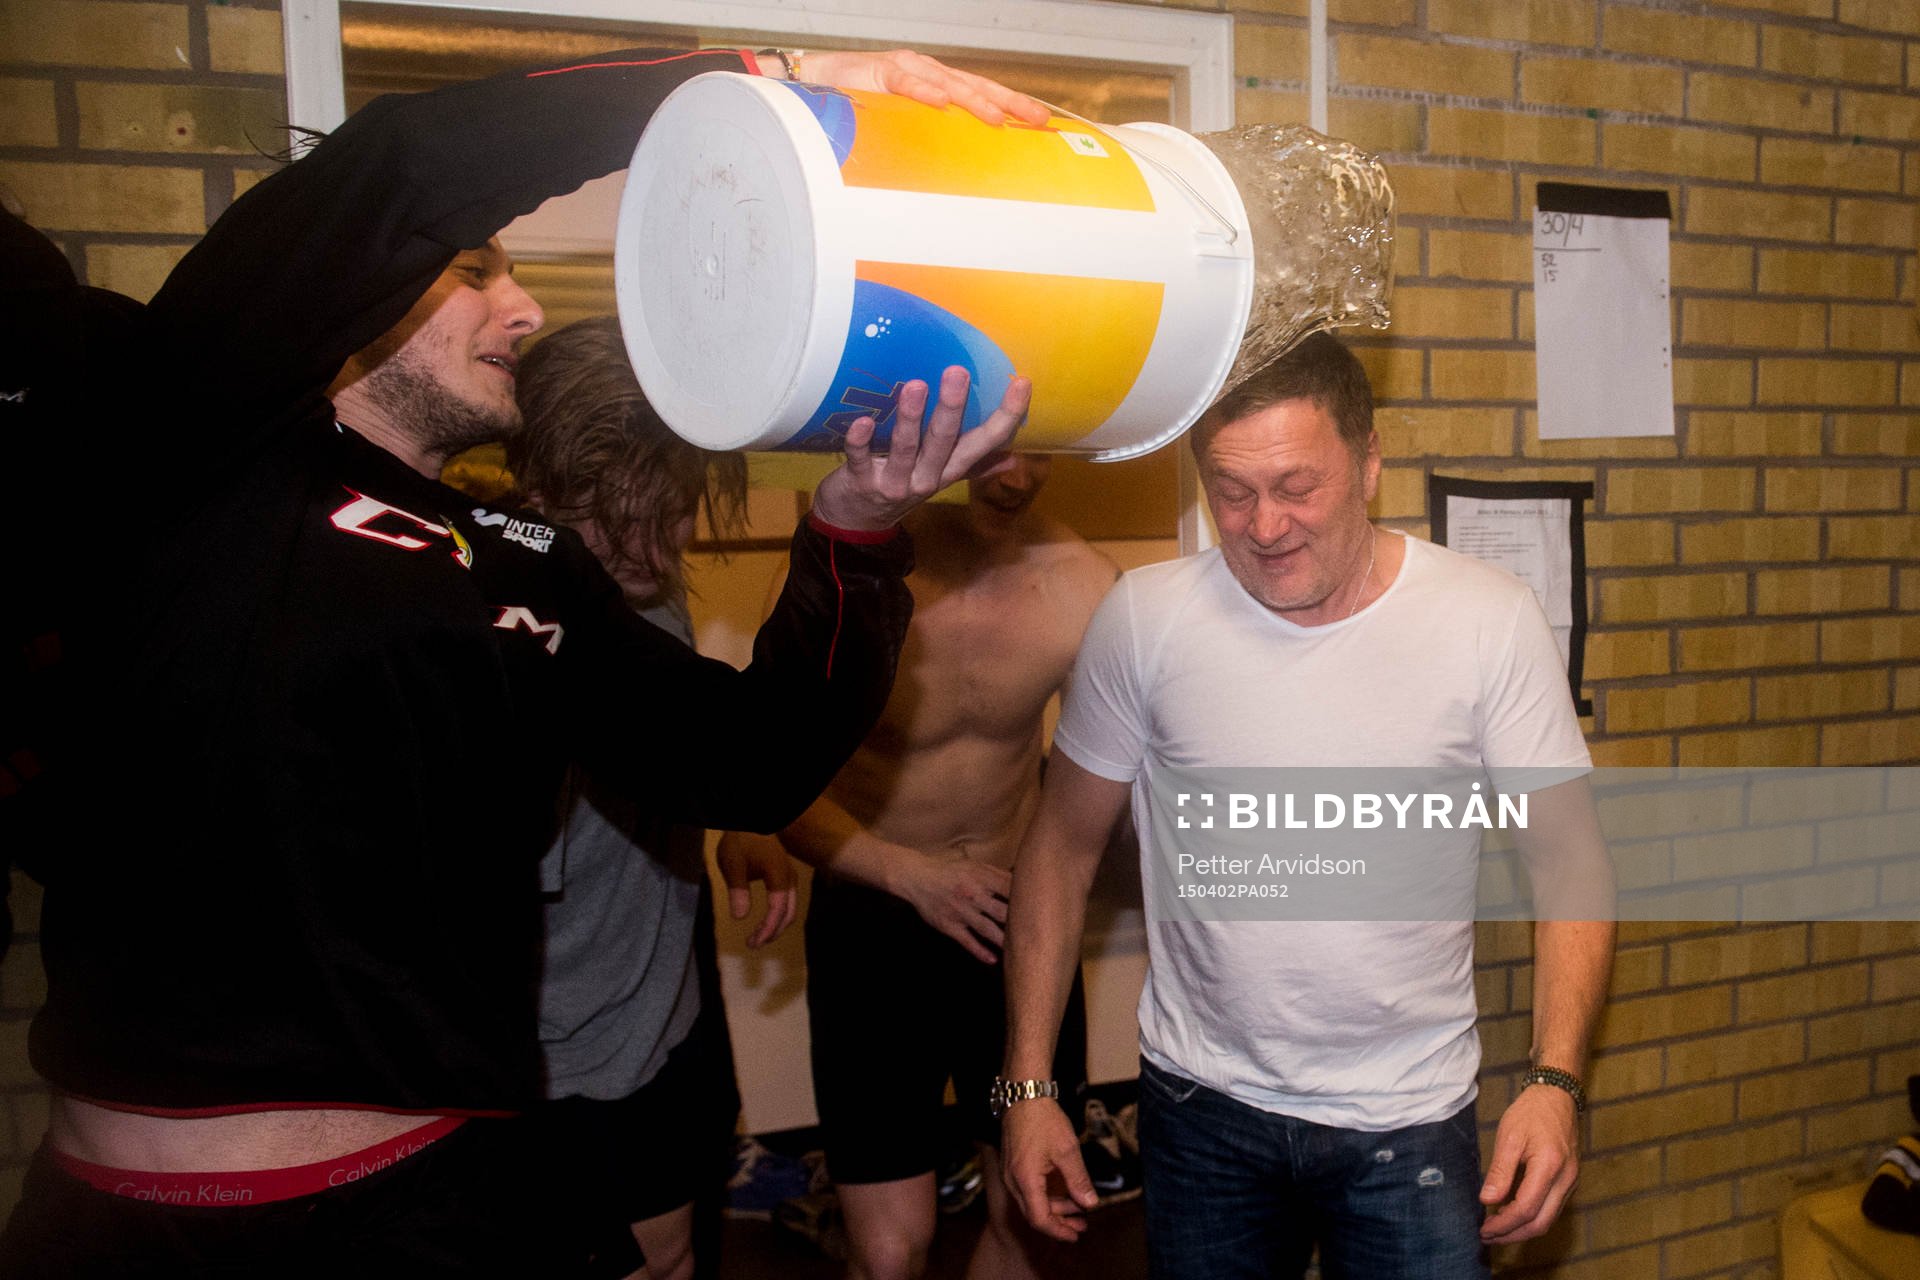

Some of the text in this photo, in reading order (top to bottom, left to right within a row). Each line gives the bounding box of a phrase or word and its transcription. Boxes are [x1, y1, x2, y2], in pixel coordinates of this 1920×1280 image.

[1540, 211, 1584, 247] 30/4
[506, 518, 556, 539] INTER
[502, 529, 553, 553] SPORT
[328, 1155, 391, 1187] Calvin
[113, 1182, 253, 1203] Calvin Klein
